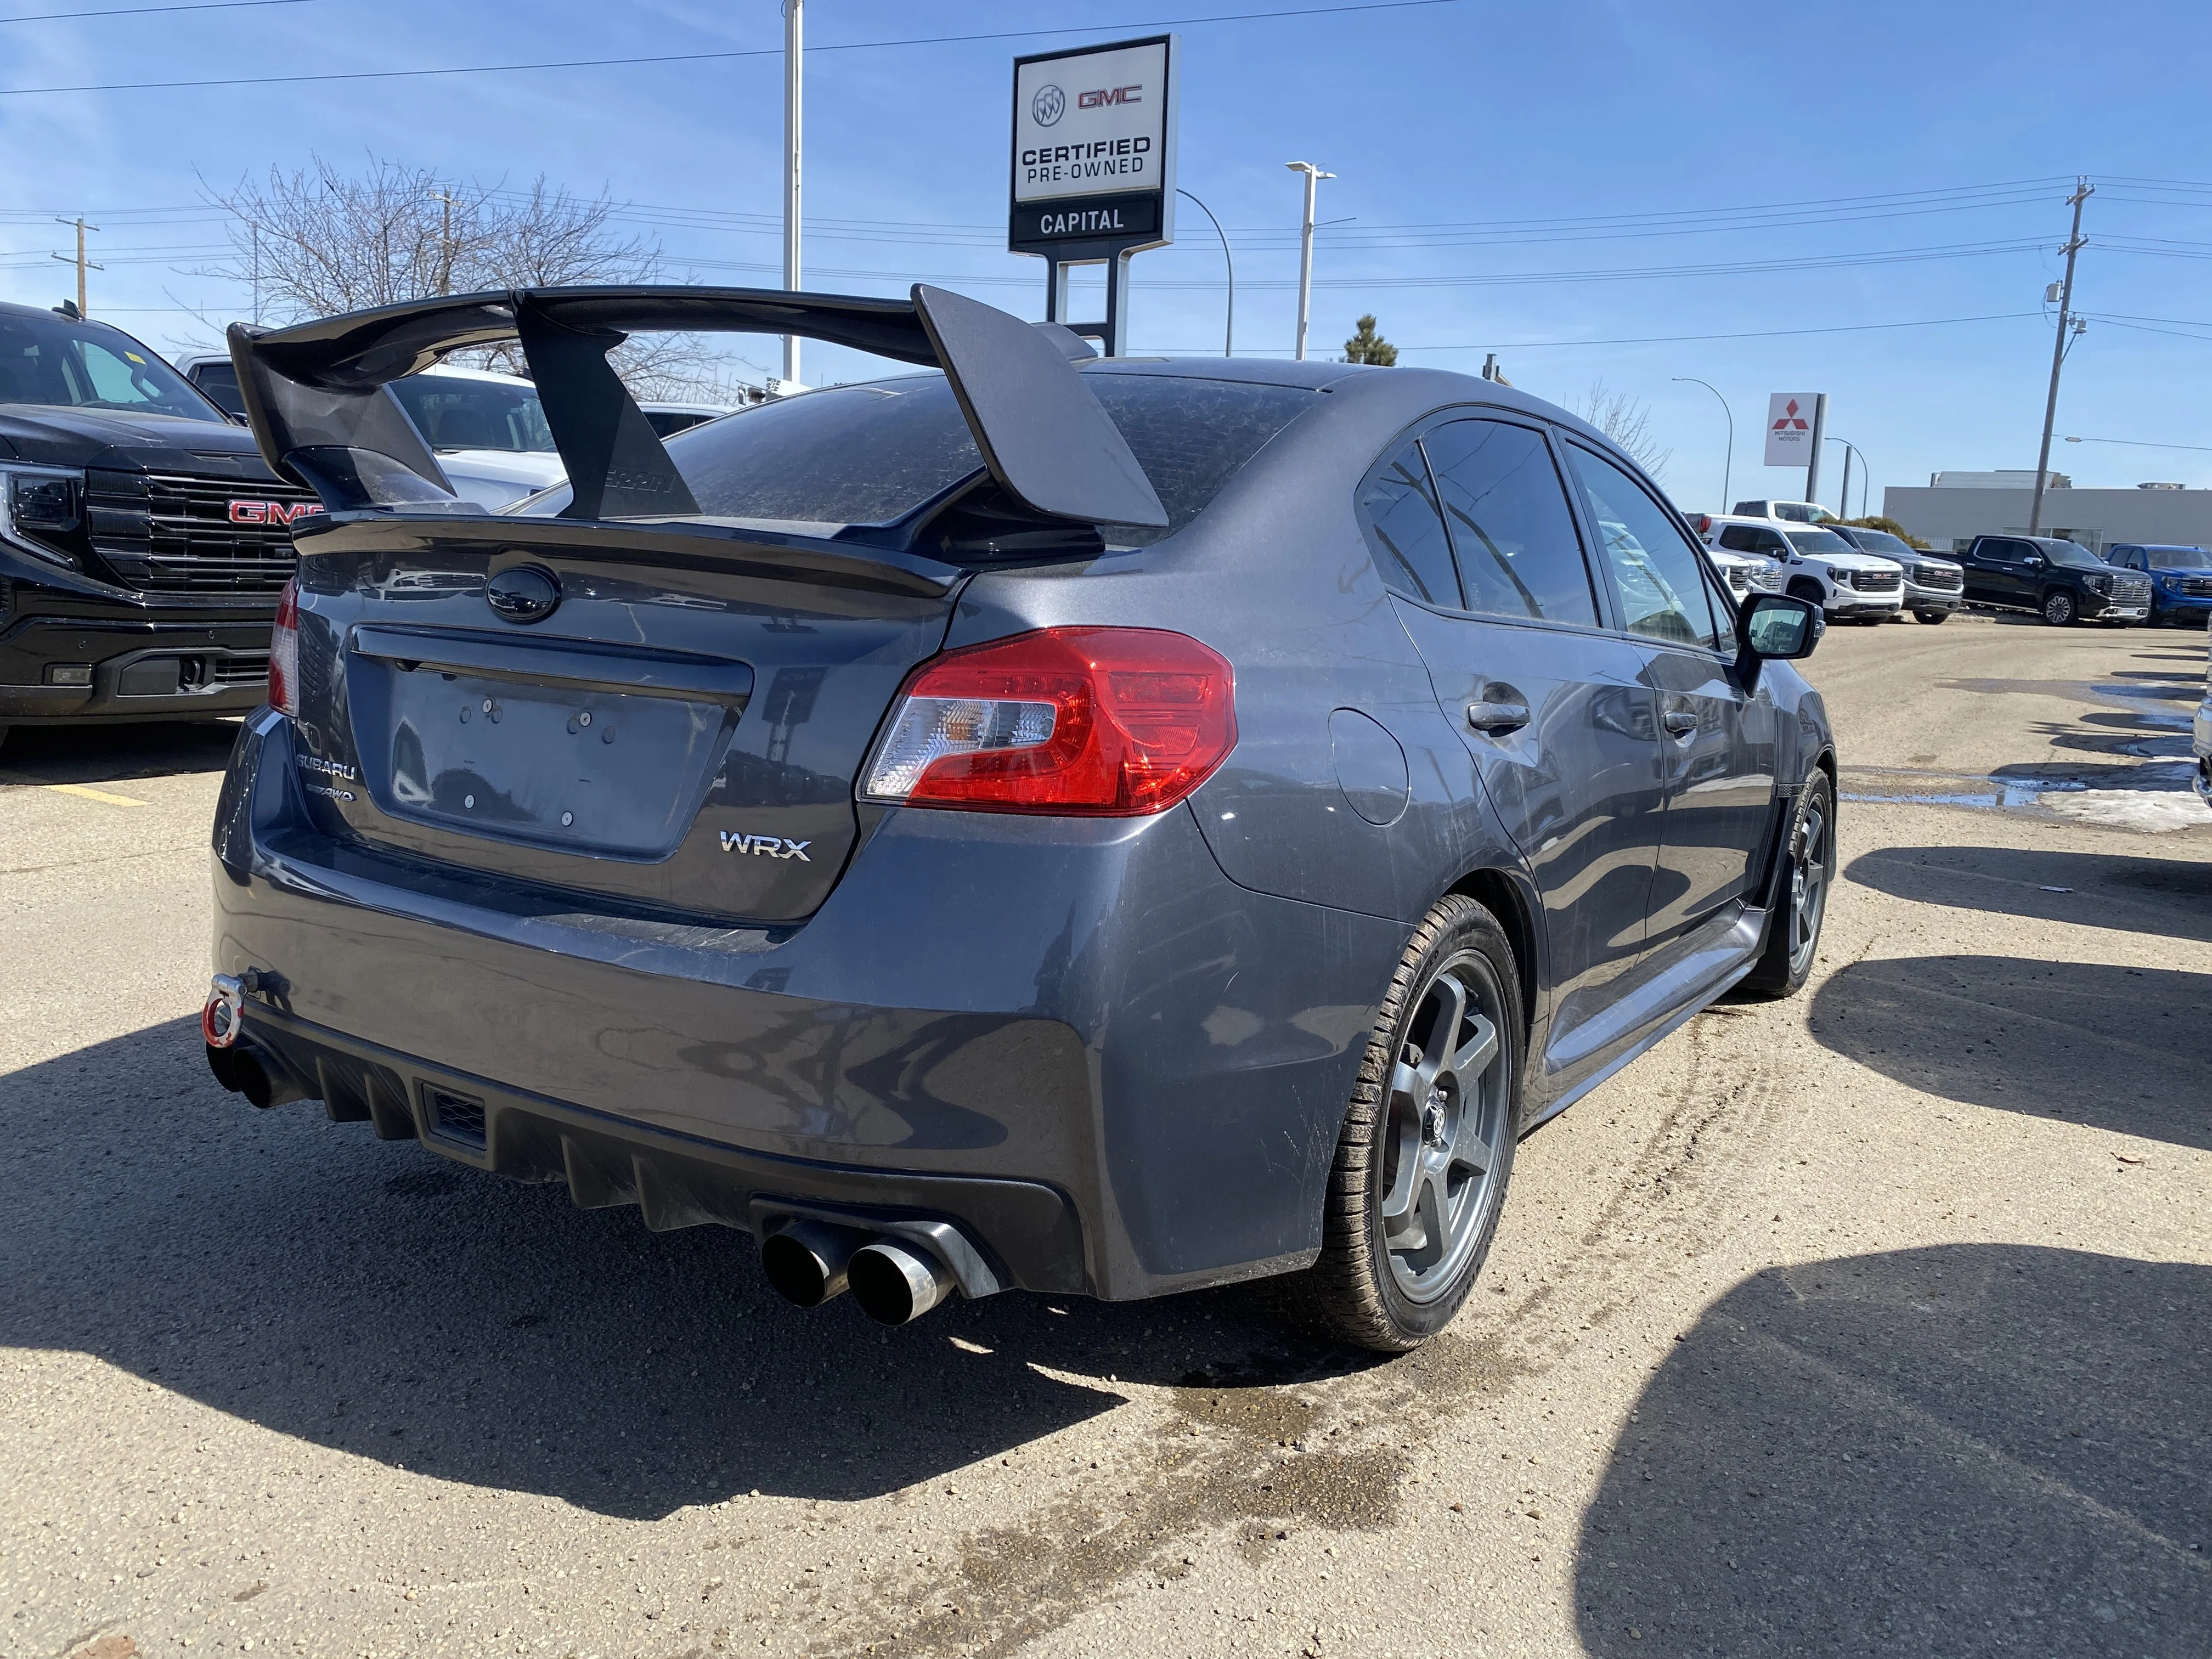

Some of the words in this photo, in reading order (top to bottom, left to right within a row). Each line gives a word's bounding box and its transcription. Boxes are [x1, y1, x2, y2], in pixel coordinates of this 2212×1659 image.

[1077, 83, 1142, 109] GMC
[1022, 136, 1150, 166] CERTIFIED
[1028, 156, 1143, 183] PRE-OWNED
[1040, 209, 1124, 234] CAPITAL
[603, 468, 676, 493] ERRIN
[296, 754, 356, 780] SUBARU
[320, 787, 357, 802] AWD
[720, 830, 812, 862] WRX
[1451, 1263, 1481, 1314] VISION
